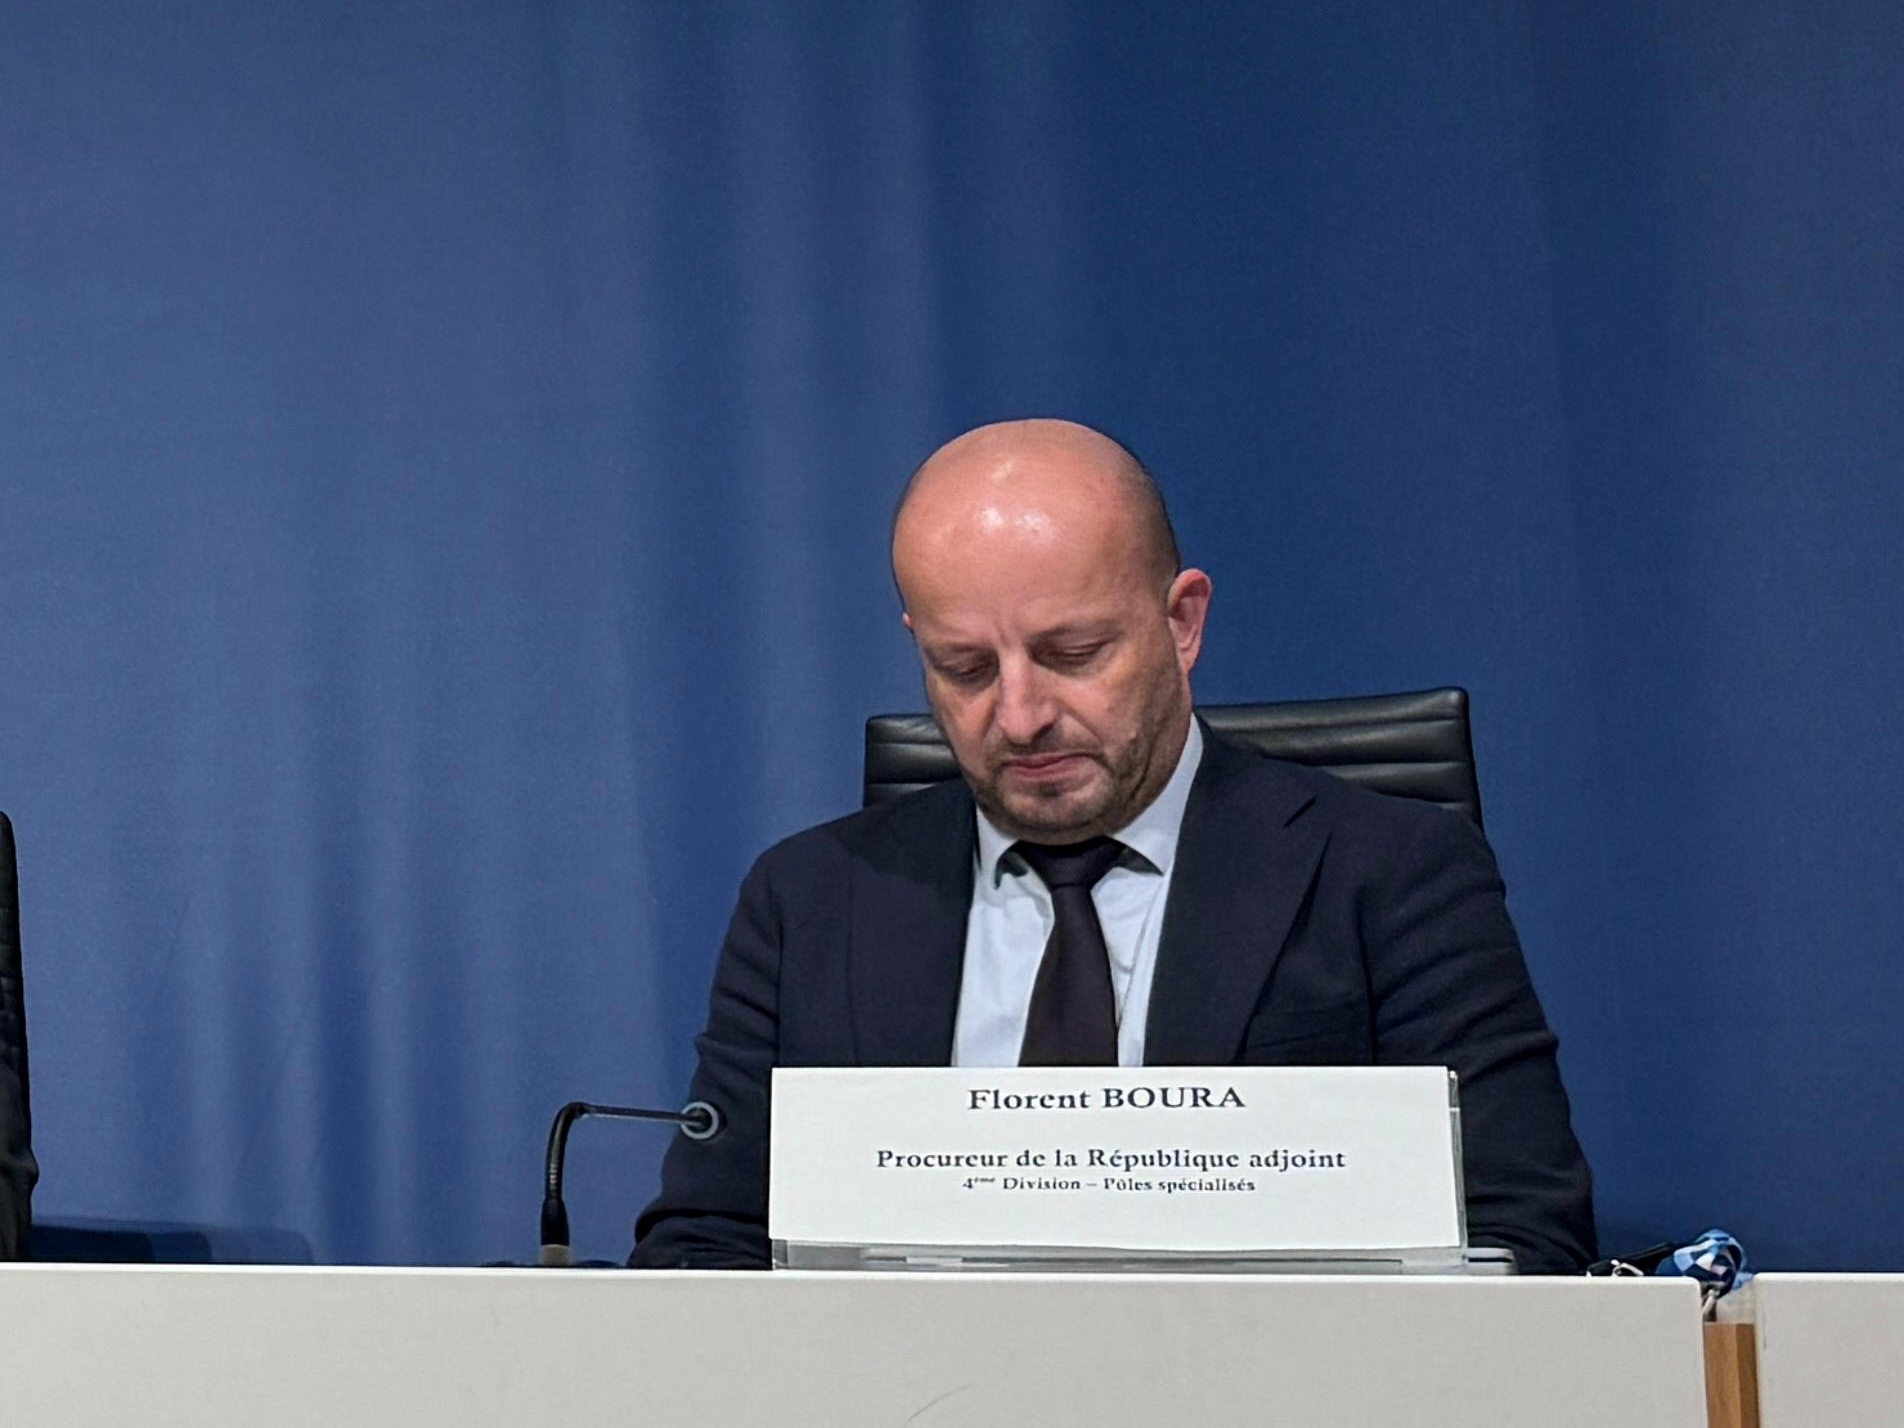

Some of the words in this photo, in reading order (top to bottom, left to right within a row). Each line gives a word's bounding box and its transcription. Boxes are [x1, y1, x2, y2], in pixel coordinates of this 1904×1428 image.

[967, 1089, 1091, 1110] Florent
[1101, 1086, 1246, 1109] BOURA
[877, 1150, 1008, 1168] Procureur
[1016, 1149, 1046, 1167] de
[1055, 1149, 1077, 1167] la
[1088, 1148, 1240, 1172] République
[1249, 1148, 1346, 1172] adjoint
[1003, 1177, 1081, 1190] Division
[1104, 1177, 1153, 1191] Pôles
[1158, 1177, 1256, 1194] spécialisés
